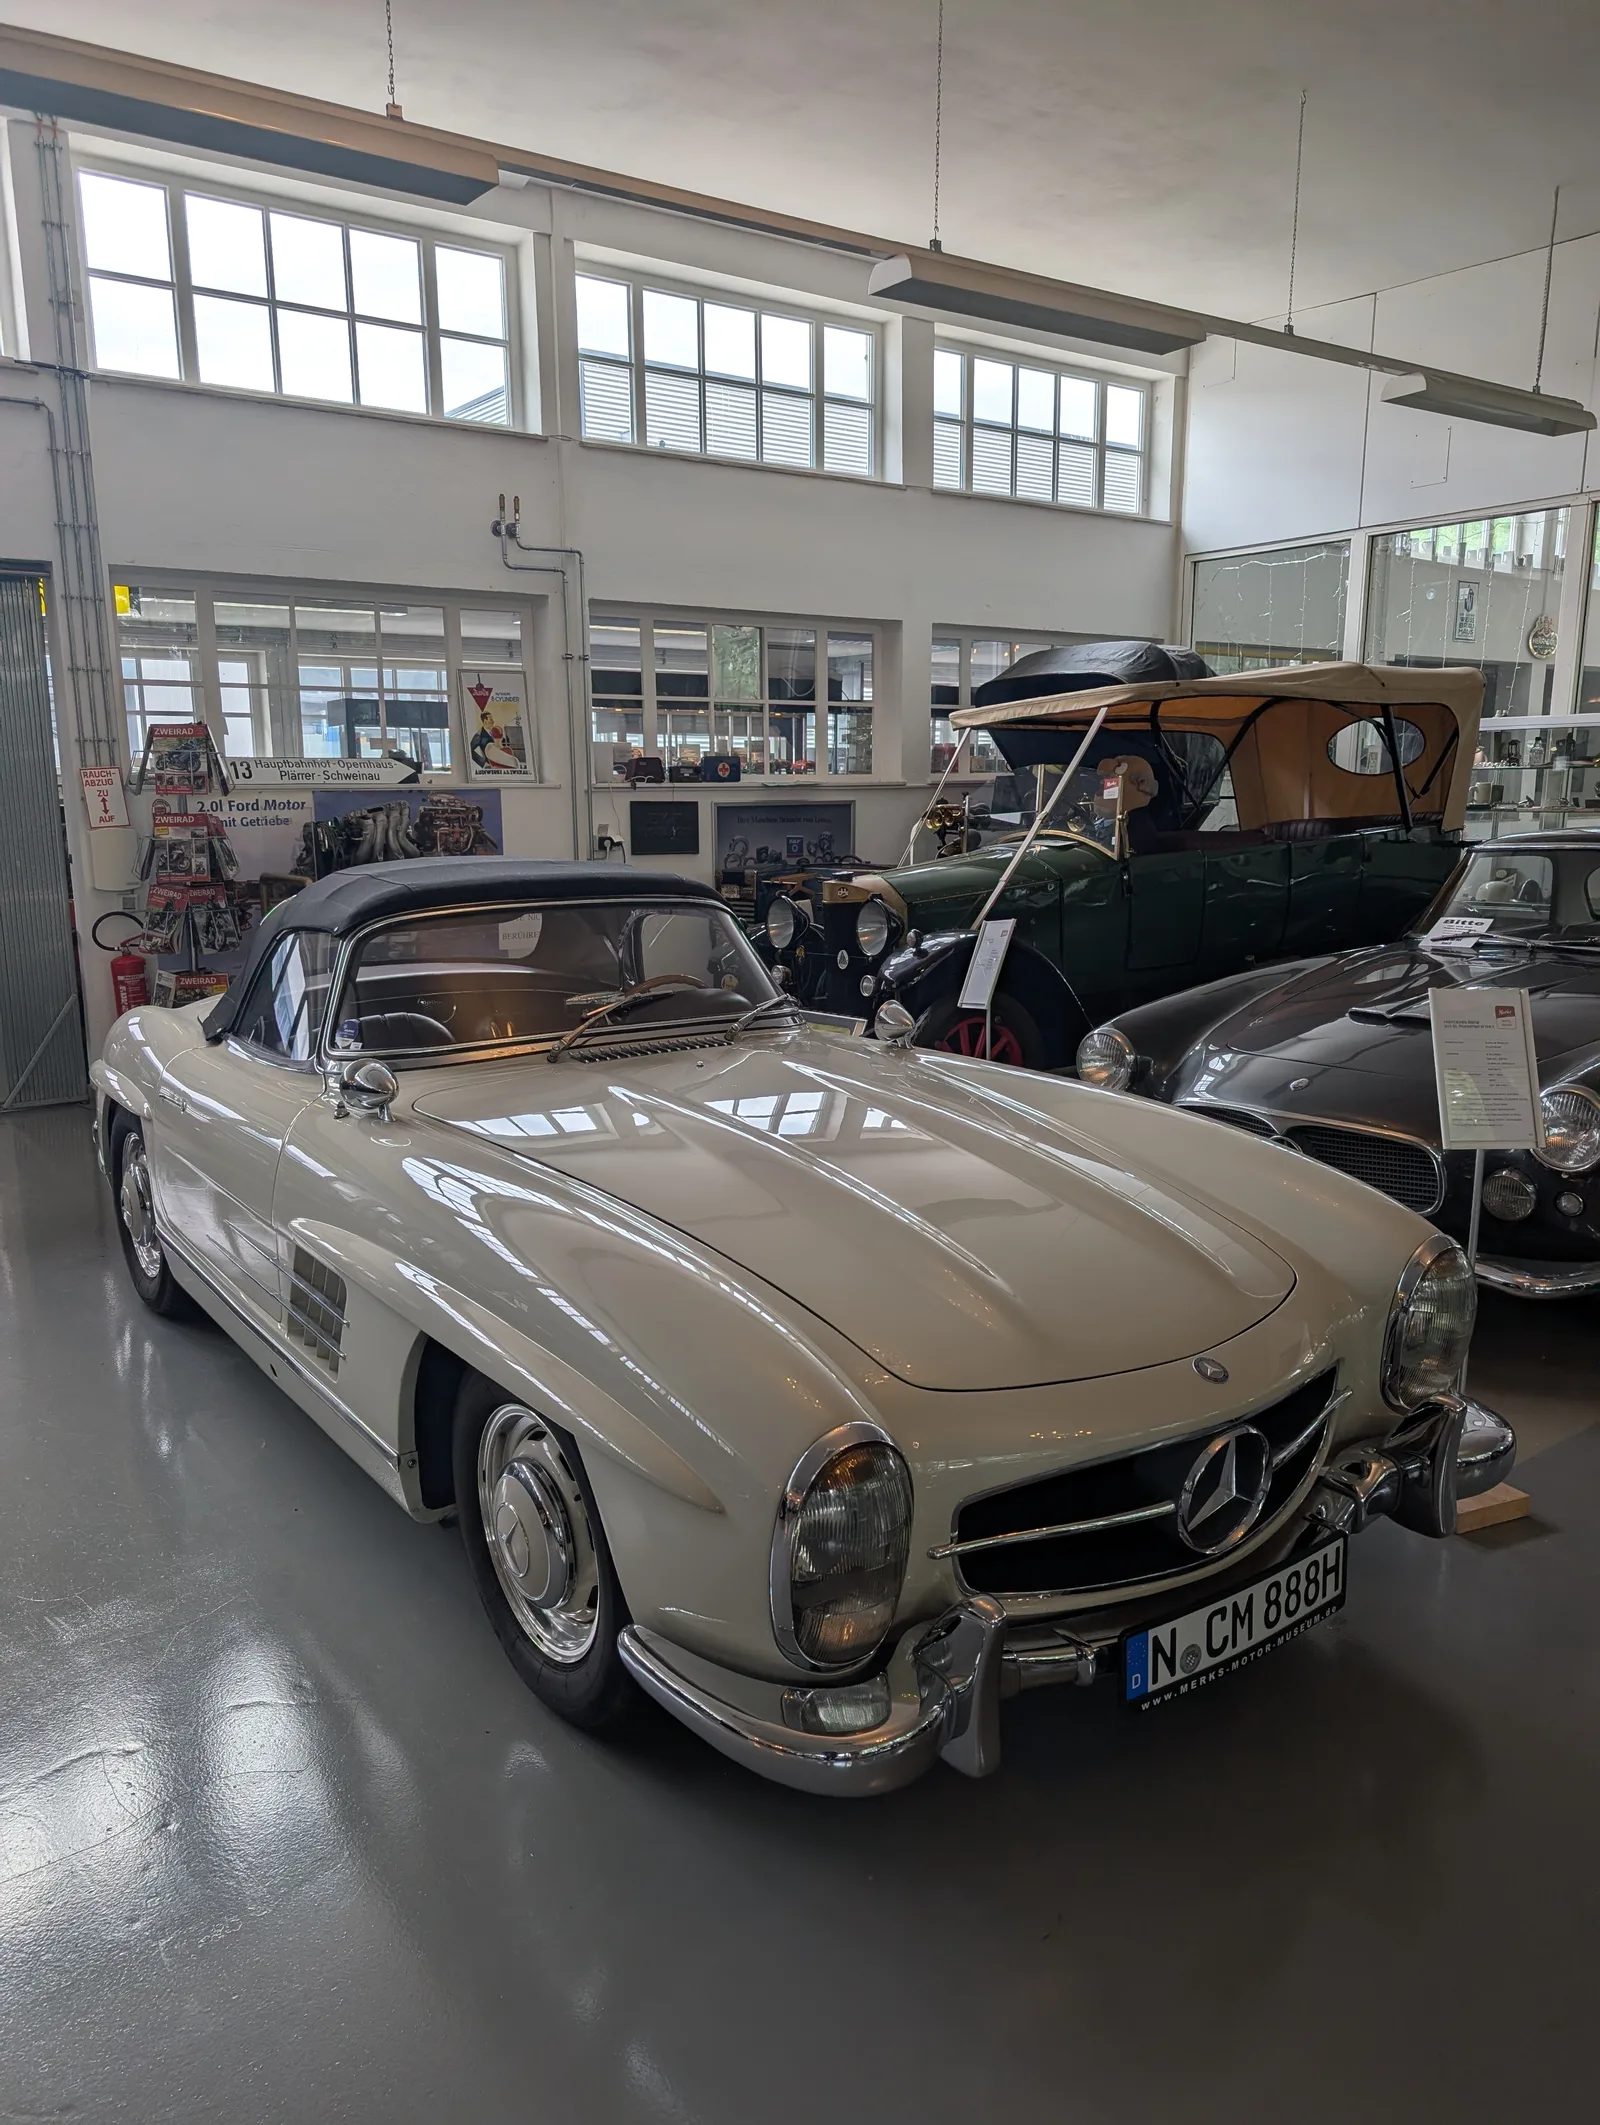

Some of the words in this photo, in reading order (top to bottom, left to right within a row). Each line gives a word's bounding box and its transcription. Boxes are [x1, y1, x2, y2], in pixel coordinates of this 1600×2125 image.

[83, 770, 116, 779] RAUCH-
[229, 761, 253, 780] 13
[85, 778, 113, 787] ABZUG
[96, 789, 109, 797] ZU
[228, 799, 259, 811] Ford
[264, 799, 306, 811] Motor
[99, 815, 115, 823] AUF
[155, 815, 195, 823] ZWEIRAD
[240, 815, 290, 827] Getriebe
[153, 886, 182, 900] ZWEIRAD
[188, 888, 216, 897] ZWEIRAD
[180, 977, 217, 985] ZWEIRAD
[1151, 1627, 1177, 1685] N
[1206, 1592, 1253, 1658] CM
[1264, 1546, 1341, 1630] 888H
[1131, 1673, 1141, 1689] D
